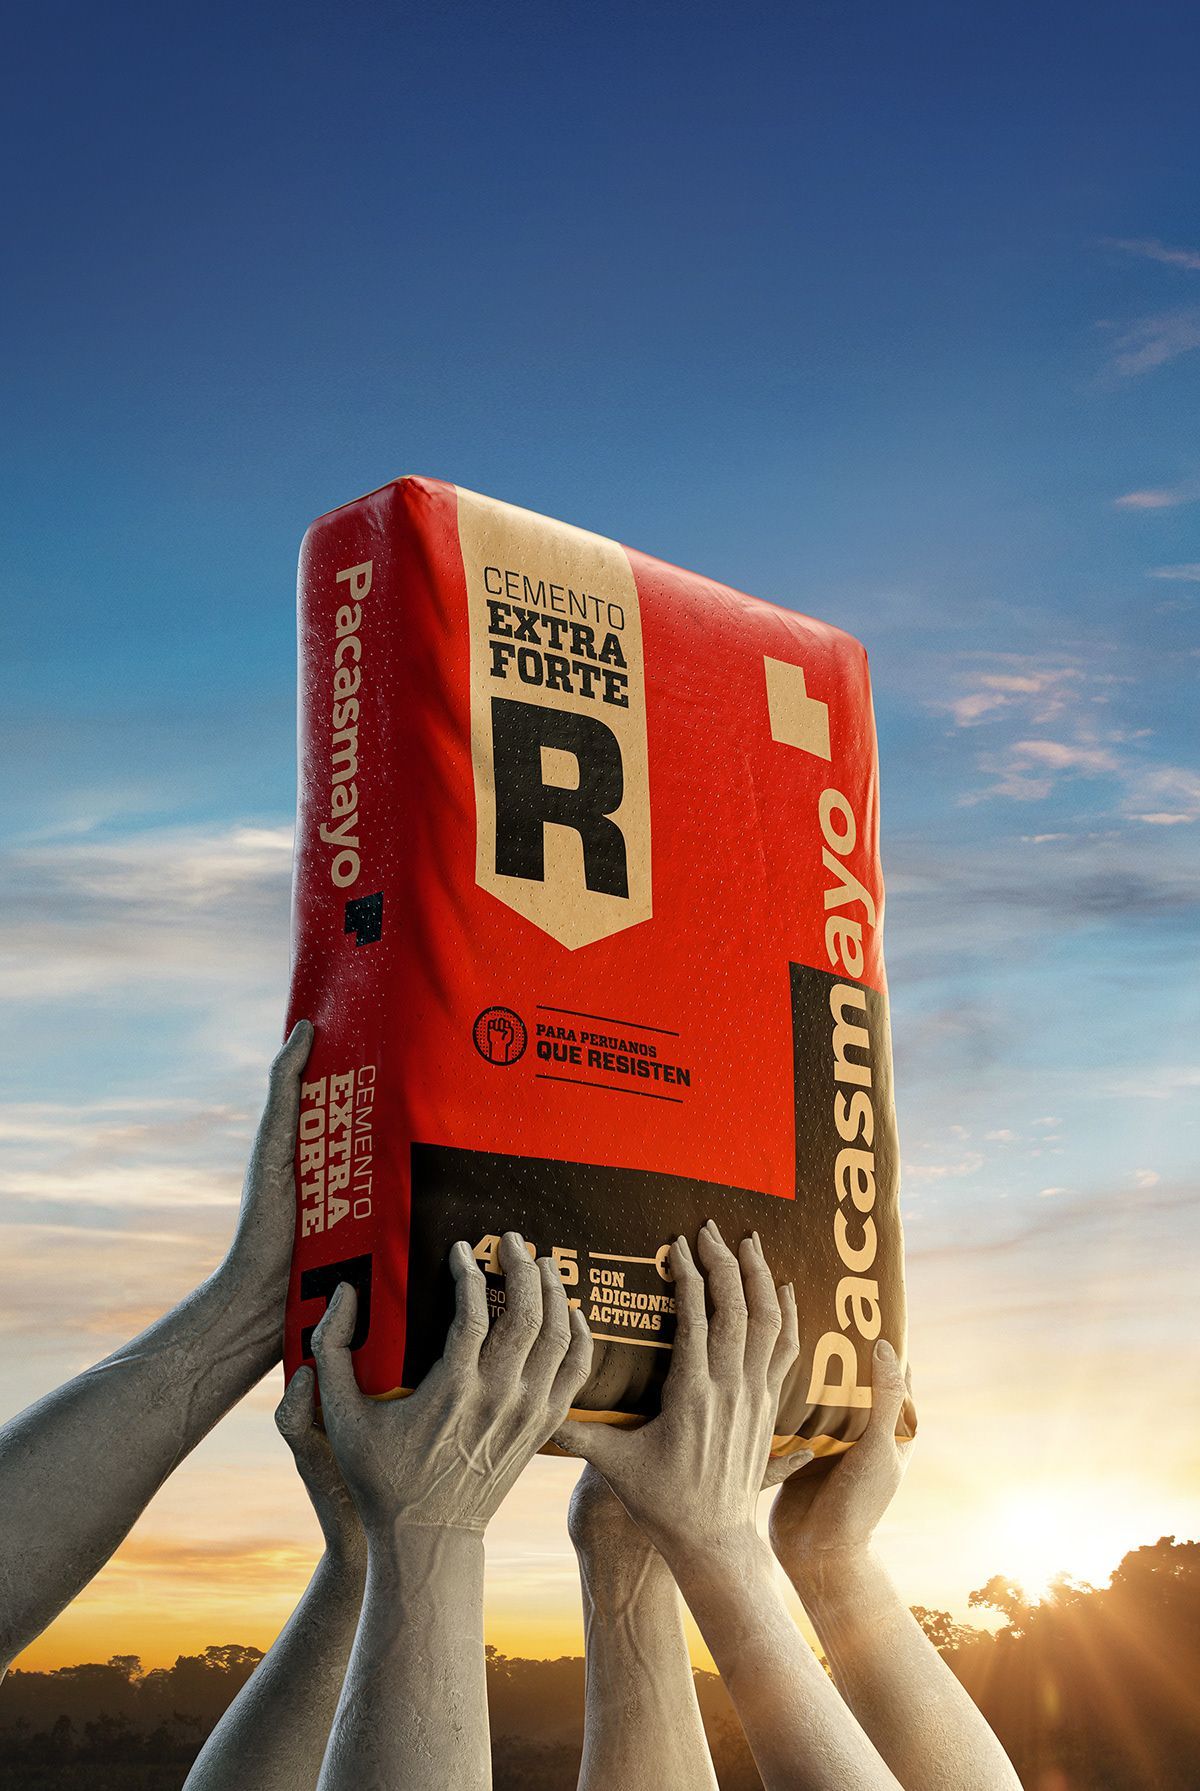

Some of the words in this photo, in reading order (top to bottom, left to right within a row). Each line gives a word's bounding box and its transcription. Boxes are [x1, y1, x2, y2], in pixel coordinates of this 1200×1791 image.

[484, 566, 625, 631] CEMENTO
[486, 599, 628, 669] EXTRA
[489, 640, 630, 709] FORTE
[319, 559, 373, 888] Pacasmayo
[491, 696, 630, 899] R
[536, 1023, 576, 1043] PARA
[580, 1031, 657, 1058] PERUANOS
[536, 1040, 582, 1065] QUE
[587, 1050, 691, 1087] RESISTEN
[806, 787, 880, 1408] Pacasmayo
[300, 1076, 327, 1238] FORTE
[327, 1069, 355, 1230] EXTRA
[353, 1065, 376, 1220] CEMENTO
[589, 1268, 625, 1288] CON
[590, 1286, 676, 1314] ADICIONES
[589, 1304, 661, 1330] ACTIVAS
